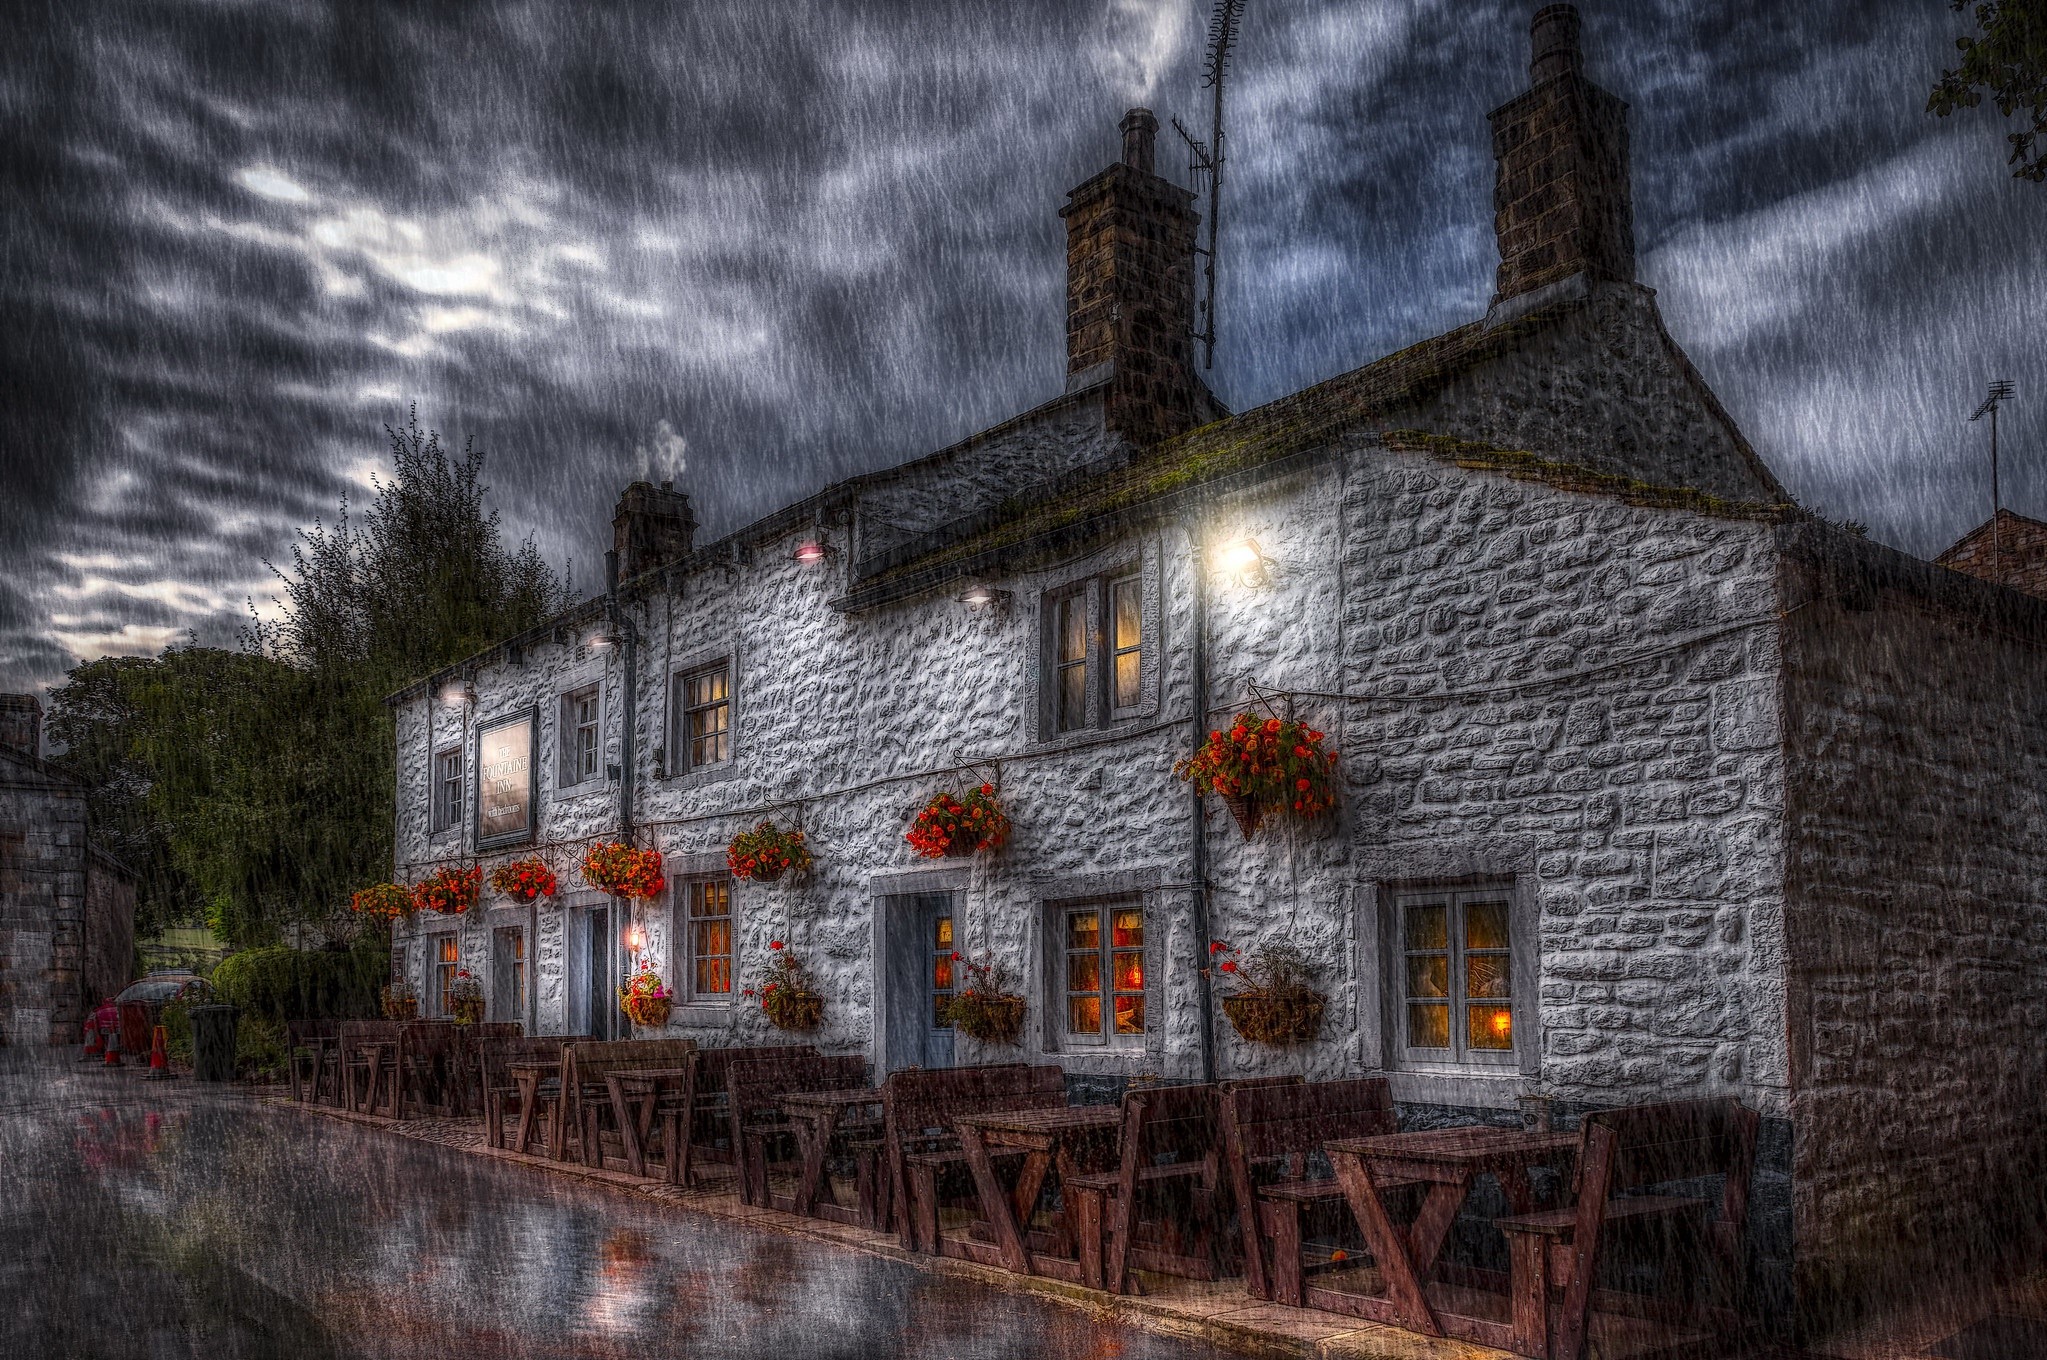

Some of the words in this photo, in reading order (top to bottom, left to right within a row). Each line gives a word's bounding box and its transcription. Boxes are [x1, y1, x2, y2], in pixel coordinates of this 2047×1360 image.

[499, 747, 511, 758] THE
[483, 757, 527, 781] FOUNTAINE
[497, 779, 512, 794] INN
